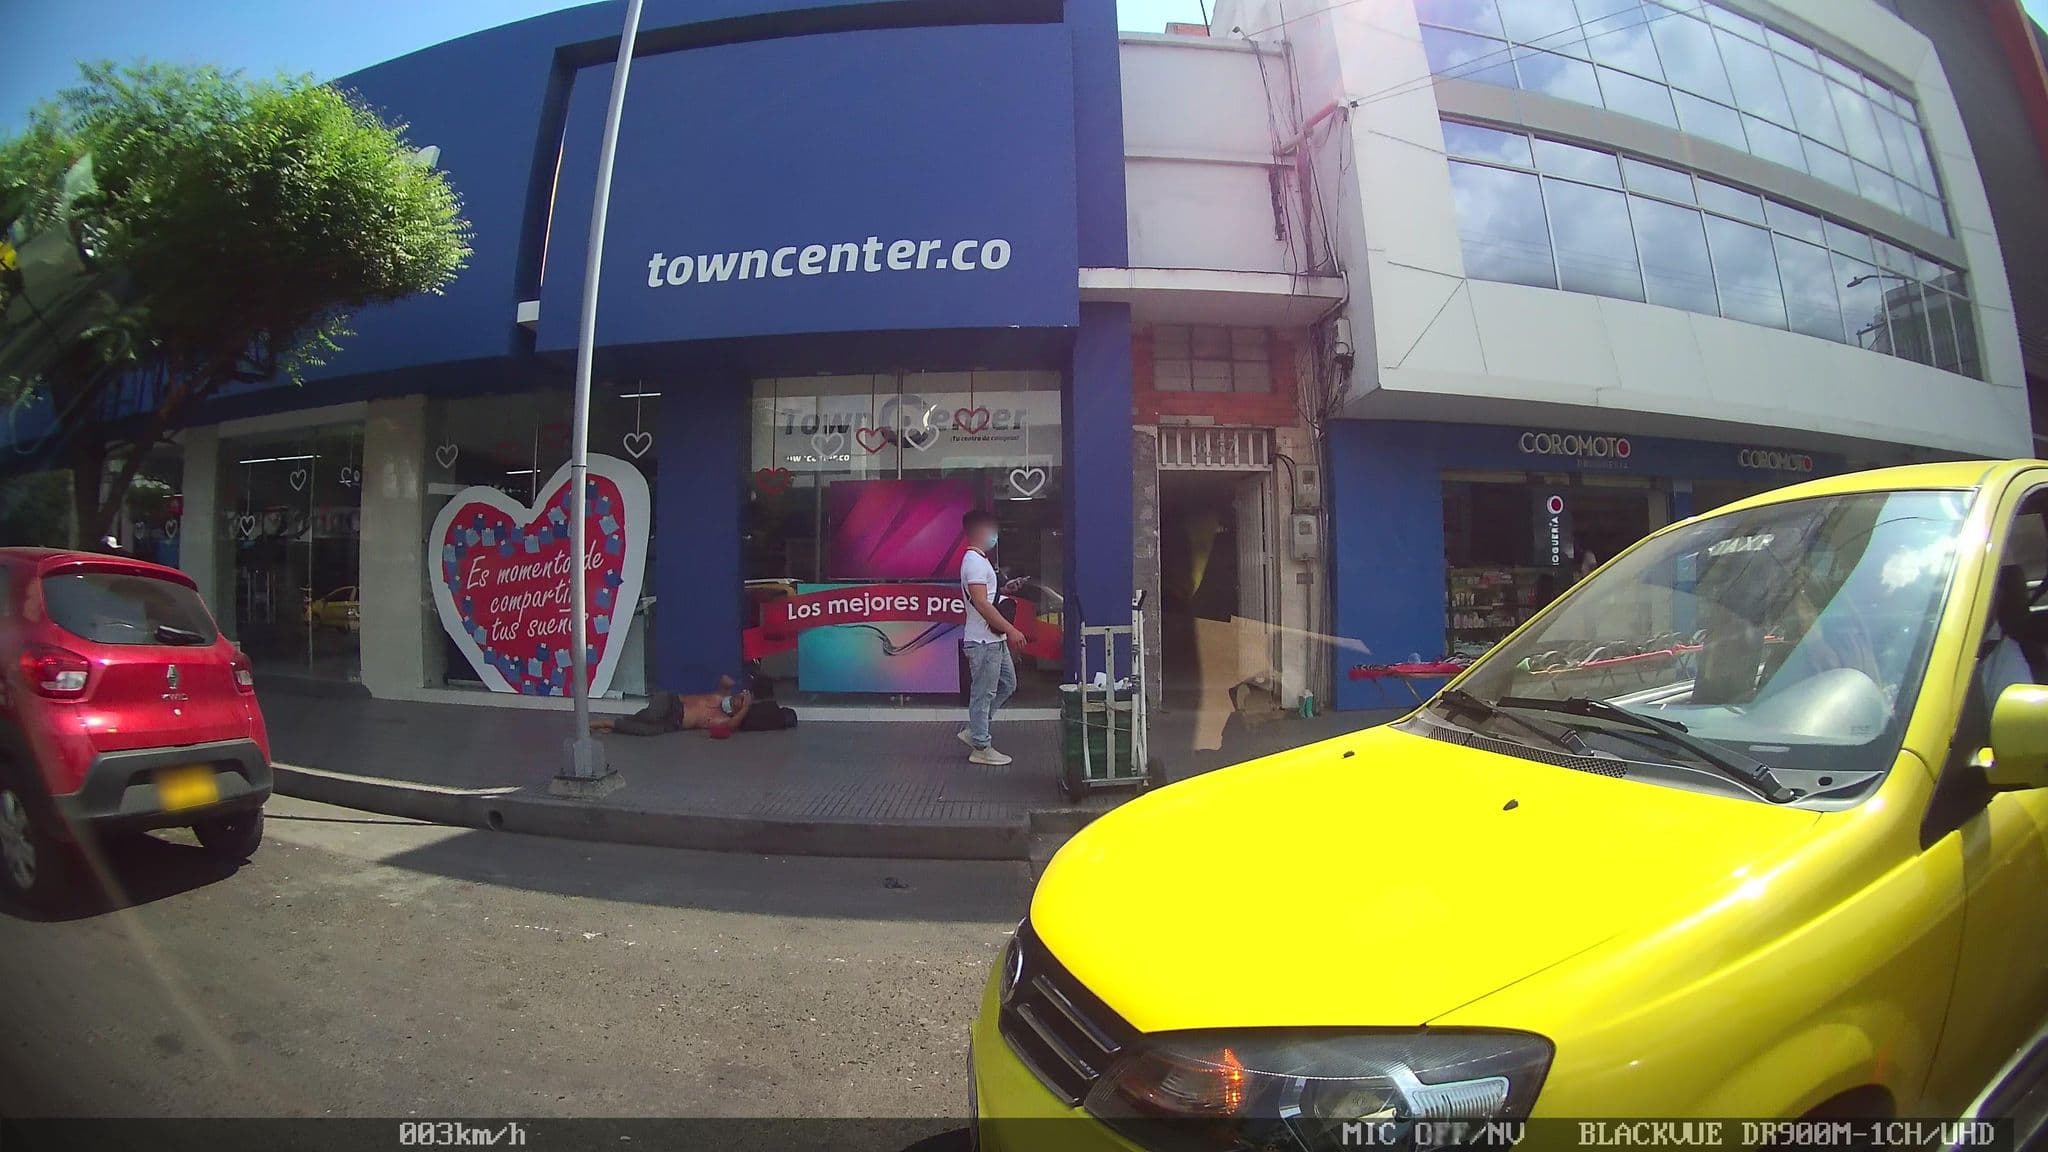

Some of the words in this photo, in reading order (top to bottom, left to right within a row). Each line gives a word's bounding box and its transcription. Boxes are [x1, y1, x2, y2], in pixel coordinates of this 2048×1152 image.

[648, 237, 1011, 287] towncenter.co
[1521, 432, 1631, 458] COROMOTO
[467, 556, 489, 589] Es
[584, 540, 605, 570] de
[491, 580, 571, 622] comparti
[788, 603, 821, 621] Los
[828, 592, 919, 618] mejores
[492, 617, 519, 641] tus
